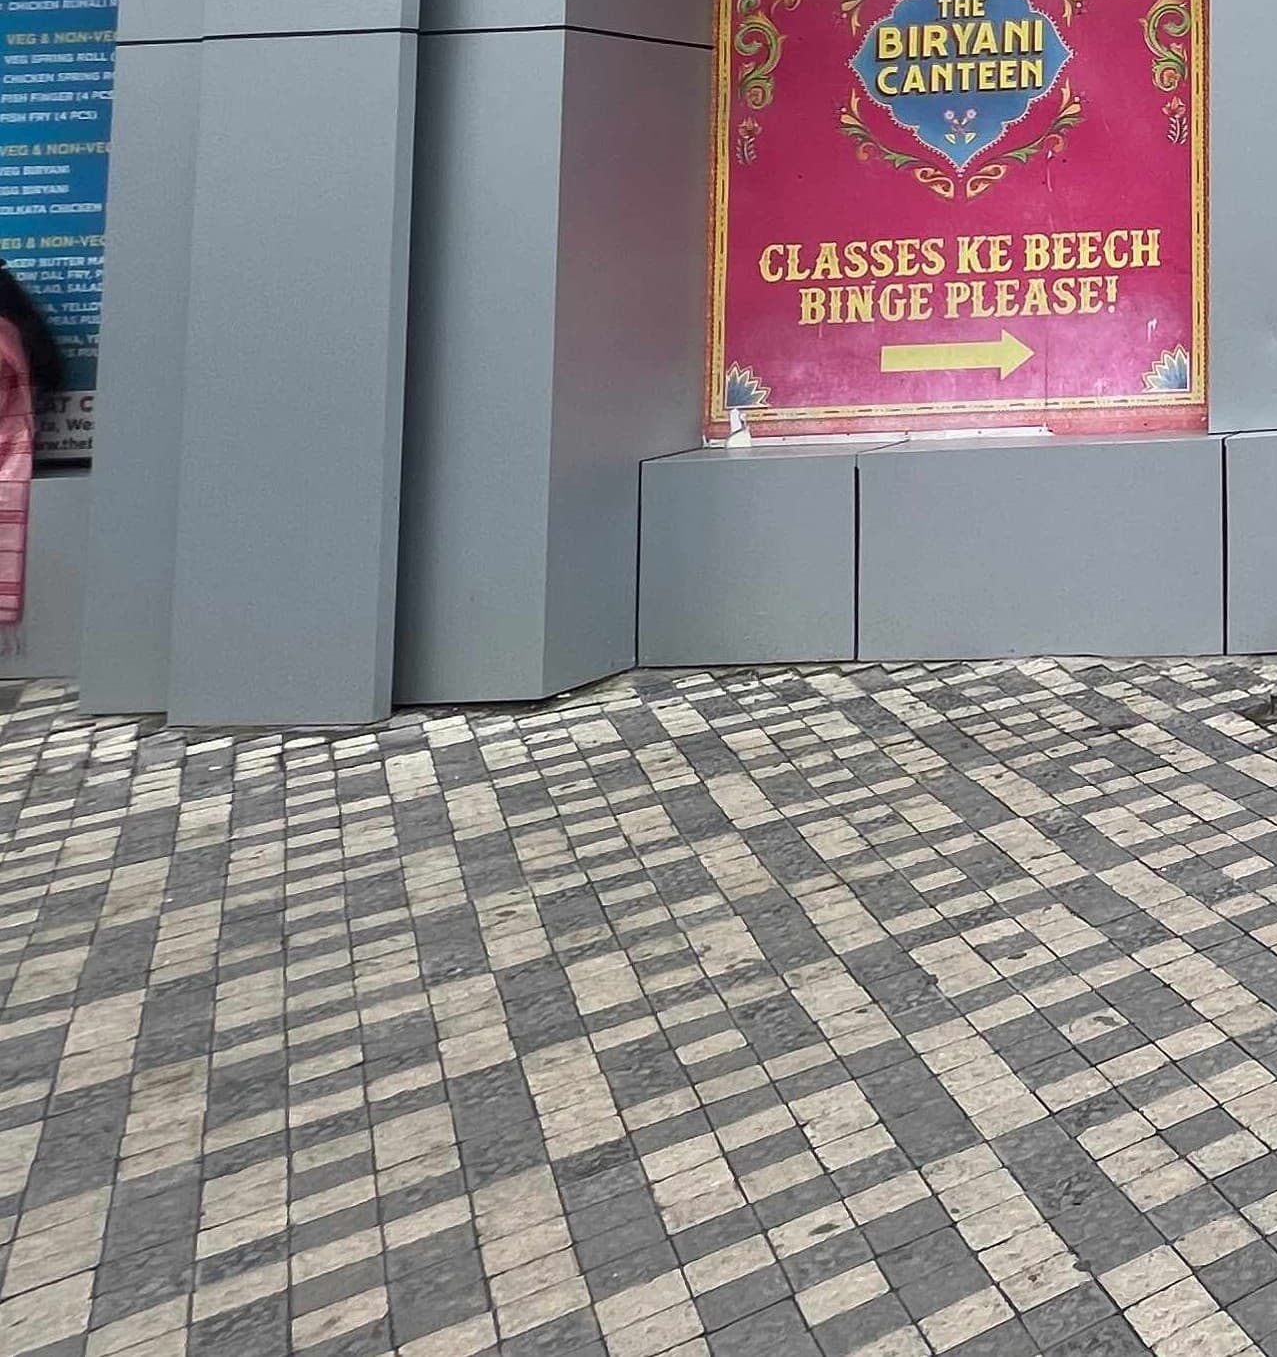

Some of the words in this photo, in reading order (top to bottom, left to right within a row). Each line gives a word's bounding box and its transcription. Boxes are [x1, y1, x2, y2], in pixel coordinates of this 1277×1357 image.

[6, 33, 37, 45] VEG
[76, 52, 107, 61] ROLL
[876, 20, 1043, 61] BIRYANI
[875, 59, 1043, 94] CANTEEN
[758, 238, 944, 282] CLASSES
[956, 235, 1012, 274] KE
[1022, 229, 1161, 273] BEECH
[798, 281, 933, 325] BINGE
[943, 274, 1119, 319] PLEASE!
